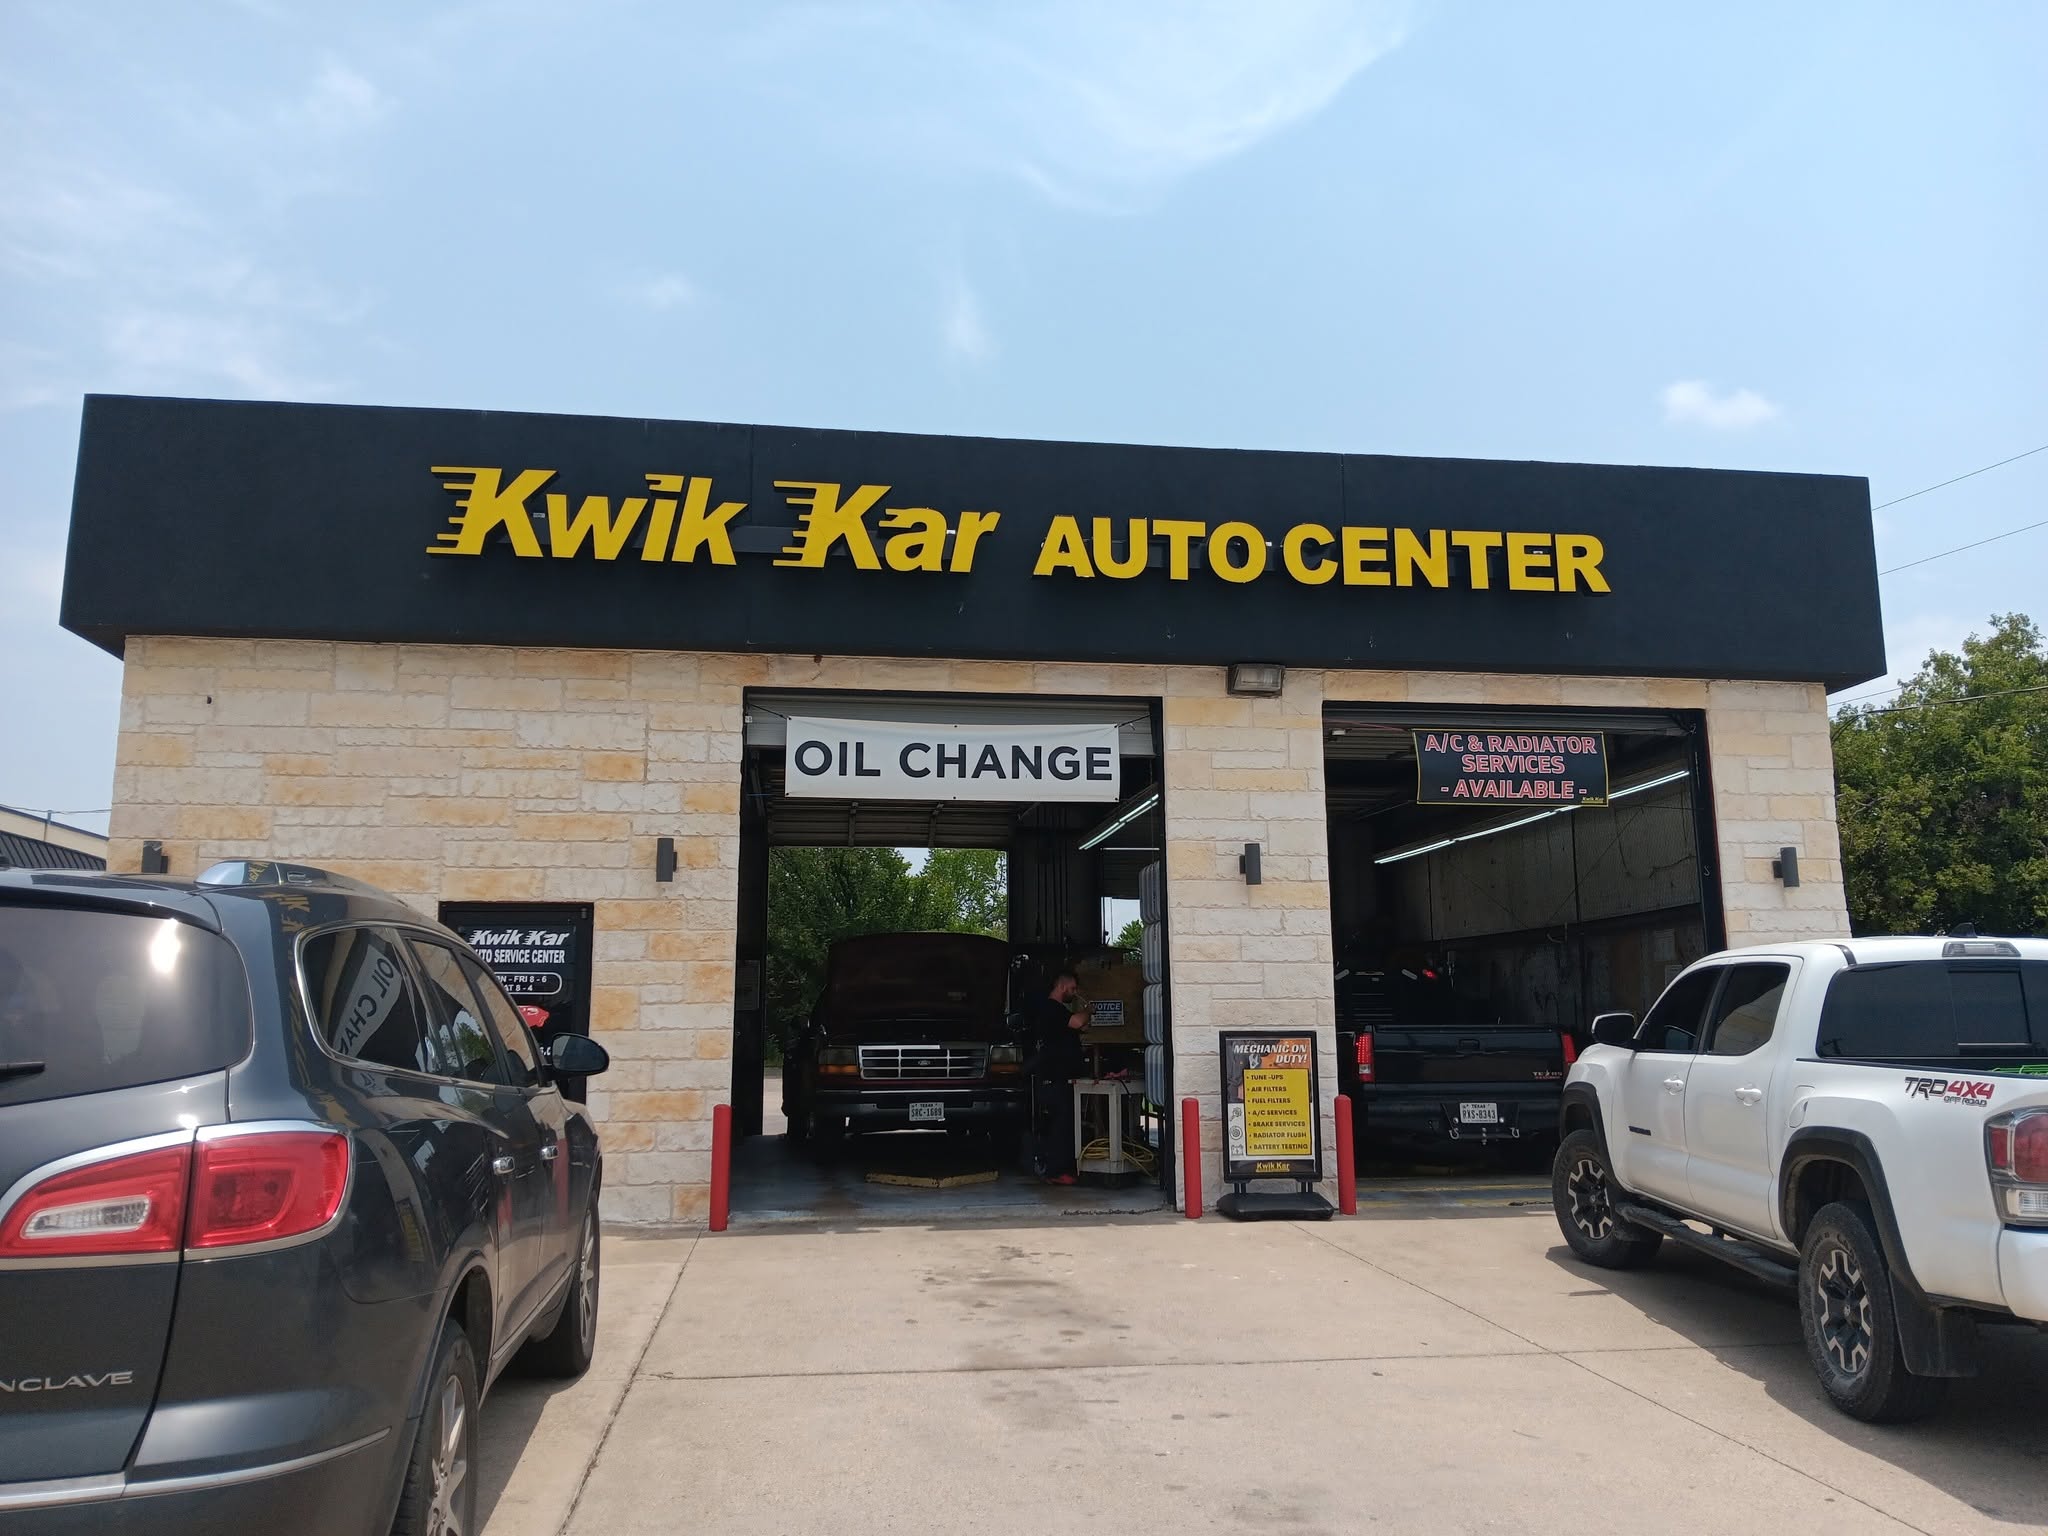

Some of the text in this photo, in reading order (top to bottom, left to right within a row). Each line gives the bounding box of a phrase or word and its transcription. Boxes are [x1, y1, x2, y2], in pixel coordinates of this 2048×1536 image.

[426, 466, 1612, 593] Kwik Kar AUTO CENTER
[1425, 732, 1597, 754] A/C & RADIATOR
[794, 740, 1113, 781] OIL CHANGE
[1461, 754, 1566, 774] SERVICES
[1452, 779, 1574, 799] AVAILABLE
[468, 929, 570, 946] Kwik Kar
[494, 949, 530, 963] SERVICE
[532, 949, 565, 964] CENTER
[1233, 1044, 1307, 1054] MECHANIC ON
[1275, 1054, 1307, 1063] DUTY!
[1962, 1098, 1988, 1107] ROAD
[0, 1371, 133, 1392] NCLAVE
